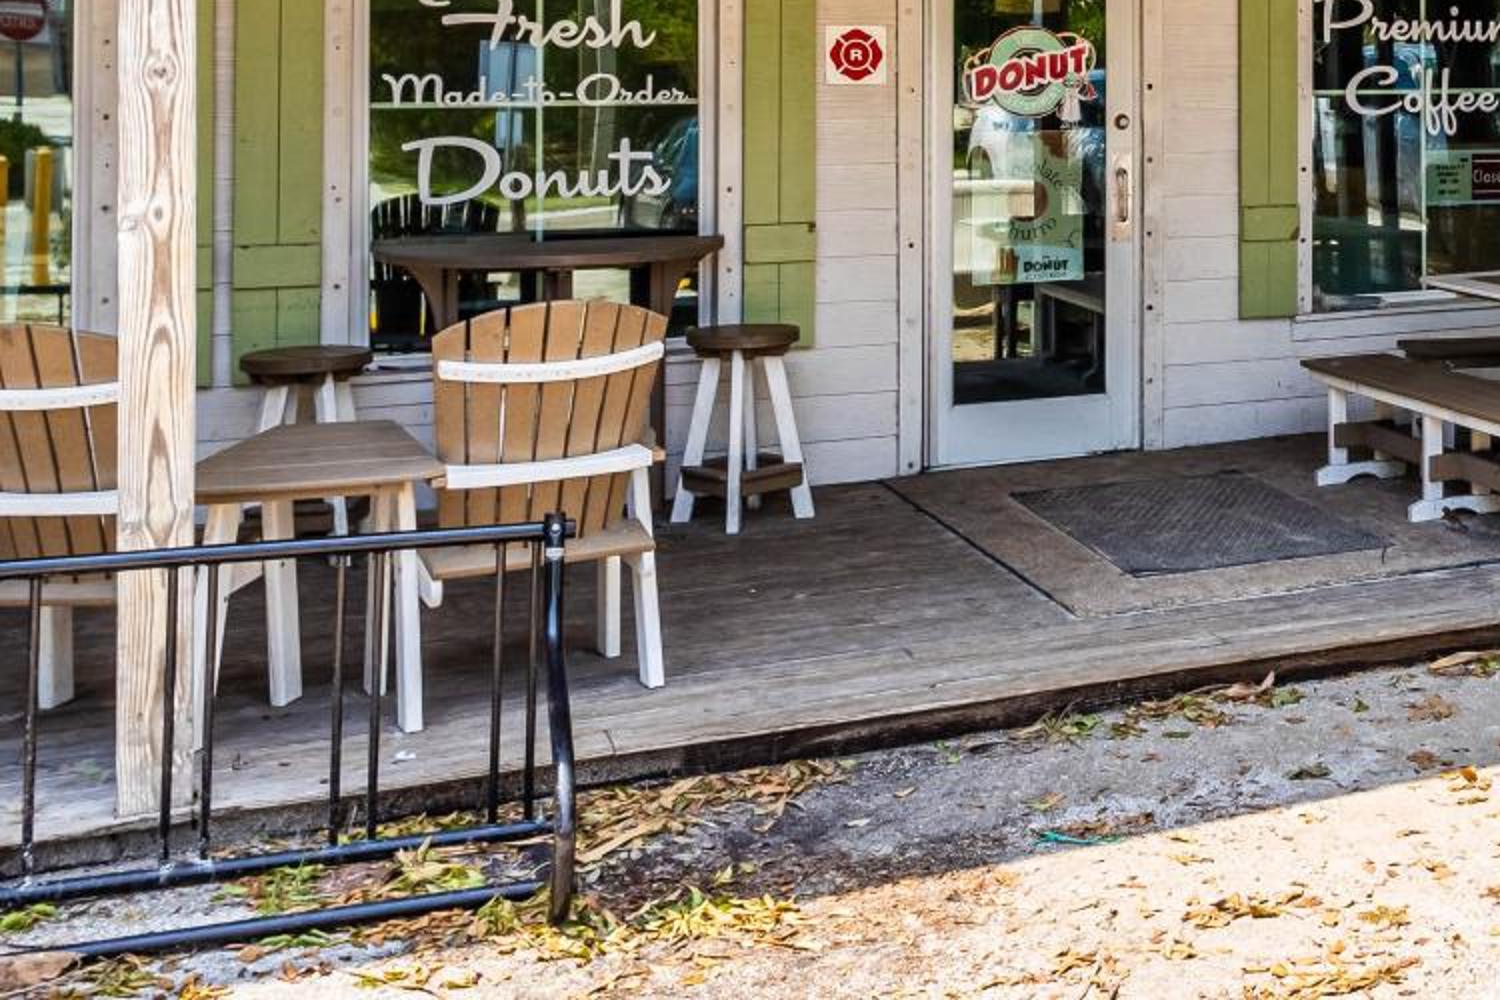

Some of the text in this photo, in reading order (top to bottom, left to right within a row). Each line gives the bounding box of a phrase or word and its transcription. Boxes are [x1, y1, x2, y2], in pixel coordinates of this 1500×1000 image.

[849, 49, 863, 61] R
[973, 44, 1088, 99] DONUT
[381, 73, 692, 106] Made-to-Order
[1345, 64, 1499, 137] Coffee
[401, 135, 671, 206] Donuts
[1023, 259, 1070, 274] DONUT
